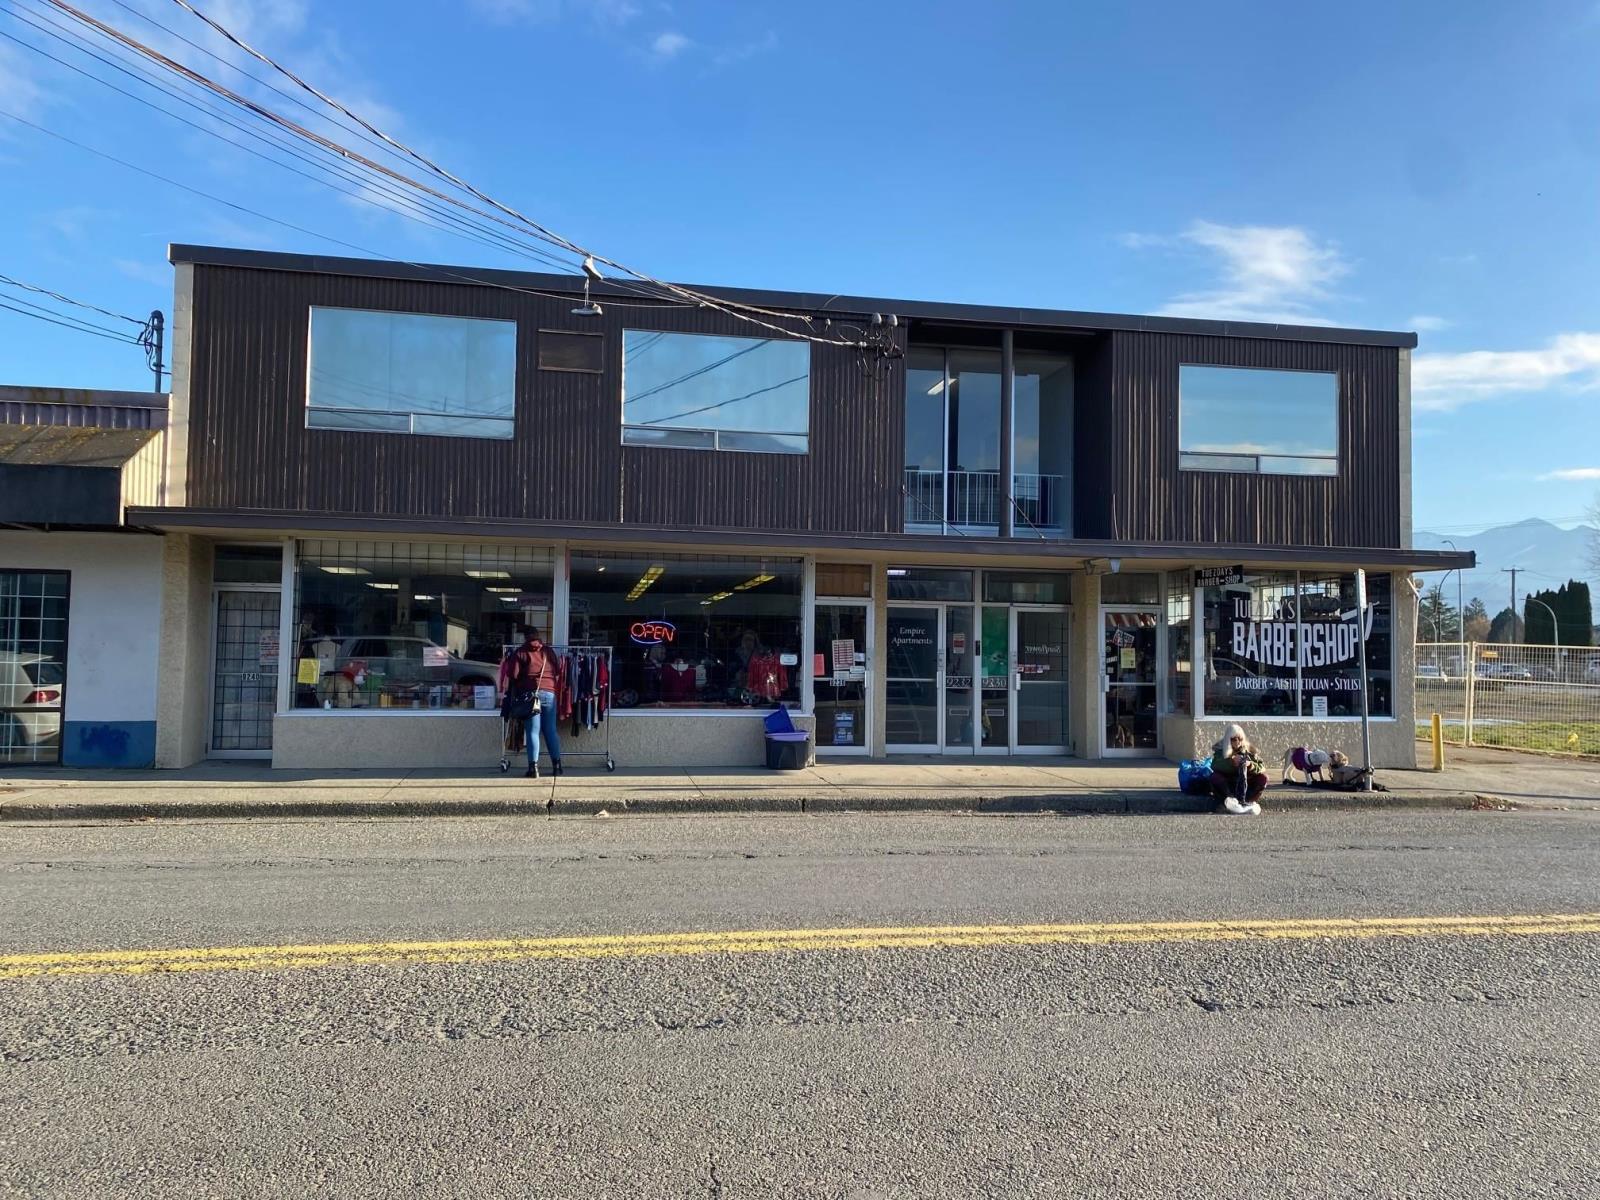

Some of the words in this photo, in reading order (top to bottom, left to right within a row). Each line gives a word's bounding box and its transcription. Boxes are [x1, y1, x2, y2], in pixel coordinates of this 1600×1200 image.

[631, 622, 674, 641] OPEN
[899, 626, 926, 637] Empire
[891, 637, 933, 647] Apartments
[1233, 621, 1359, 667] BARBERSHOP
[946, 678, 971, 688] 9232
[1235, 676, 1268, 690] BARBER
